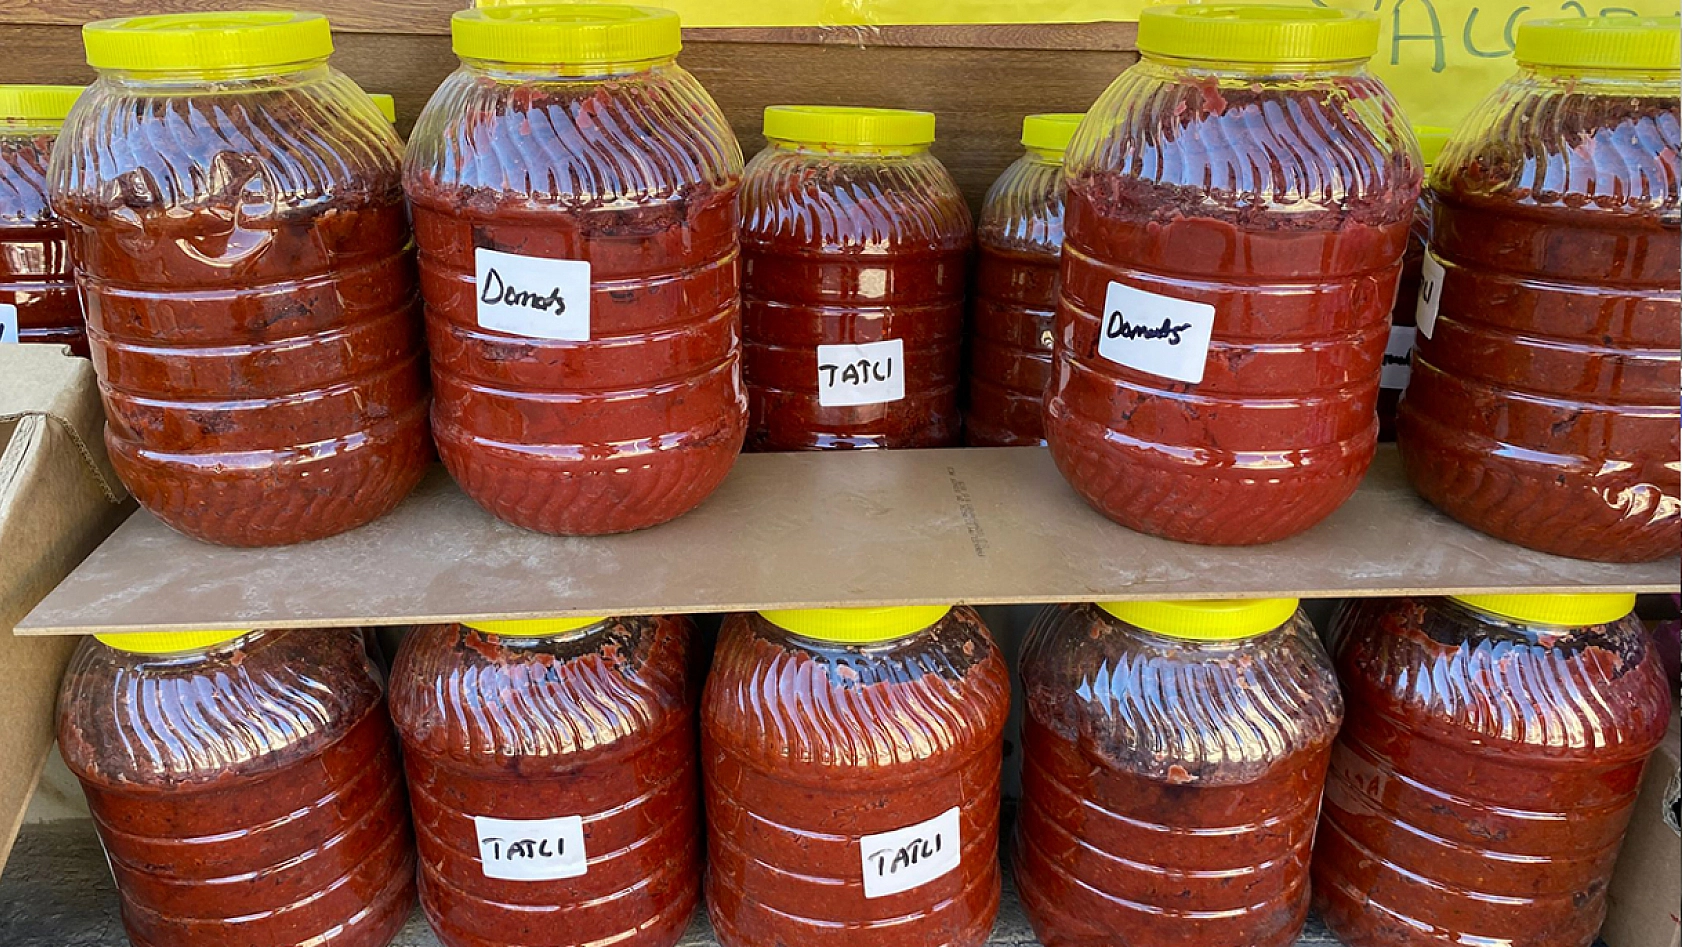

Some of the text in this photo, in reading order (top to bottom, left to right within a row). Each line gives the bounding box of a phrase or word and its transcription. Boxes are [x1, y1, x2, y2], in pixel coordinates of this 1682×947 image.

[818, 356, 892, 388] TATLI
[481, 836, 565, 861] TATLI
[867, 832, 942, 877] TATLI
